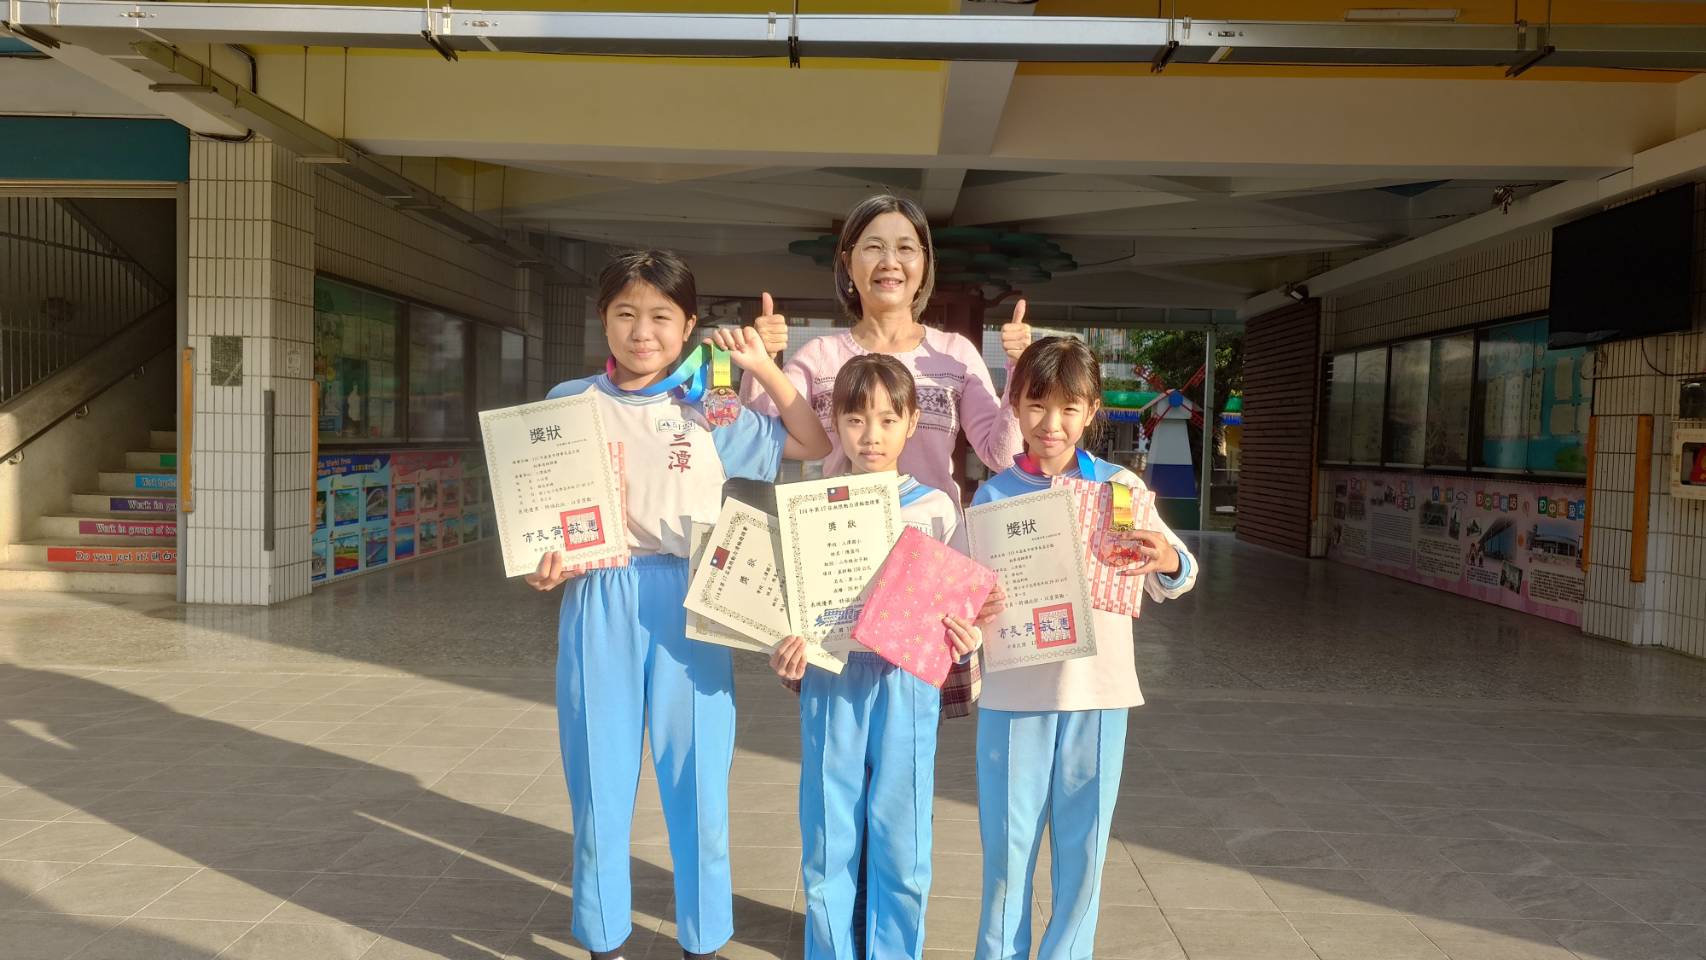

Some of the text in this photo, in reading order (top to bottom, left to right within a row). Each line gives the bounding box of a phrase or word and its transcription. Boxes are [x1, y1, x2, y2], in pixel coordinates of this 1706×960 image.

[529, 424, 562, 444] 獎狀
[667, 433, 692, 473] 三潭
[96, 523, 116, 533] Work
[1005, 518, 1037, 538] 獎狀
[75, 551, 90, 561] Do
[93, 552, 112, 561] you
